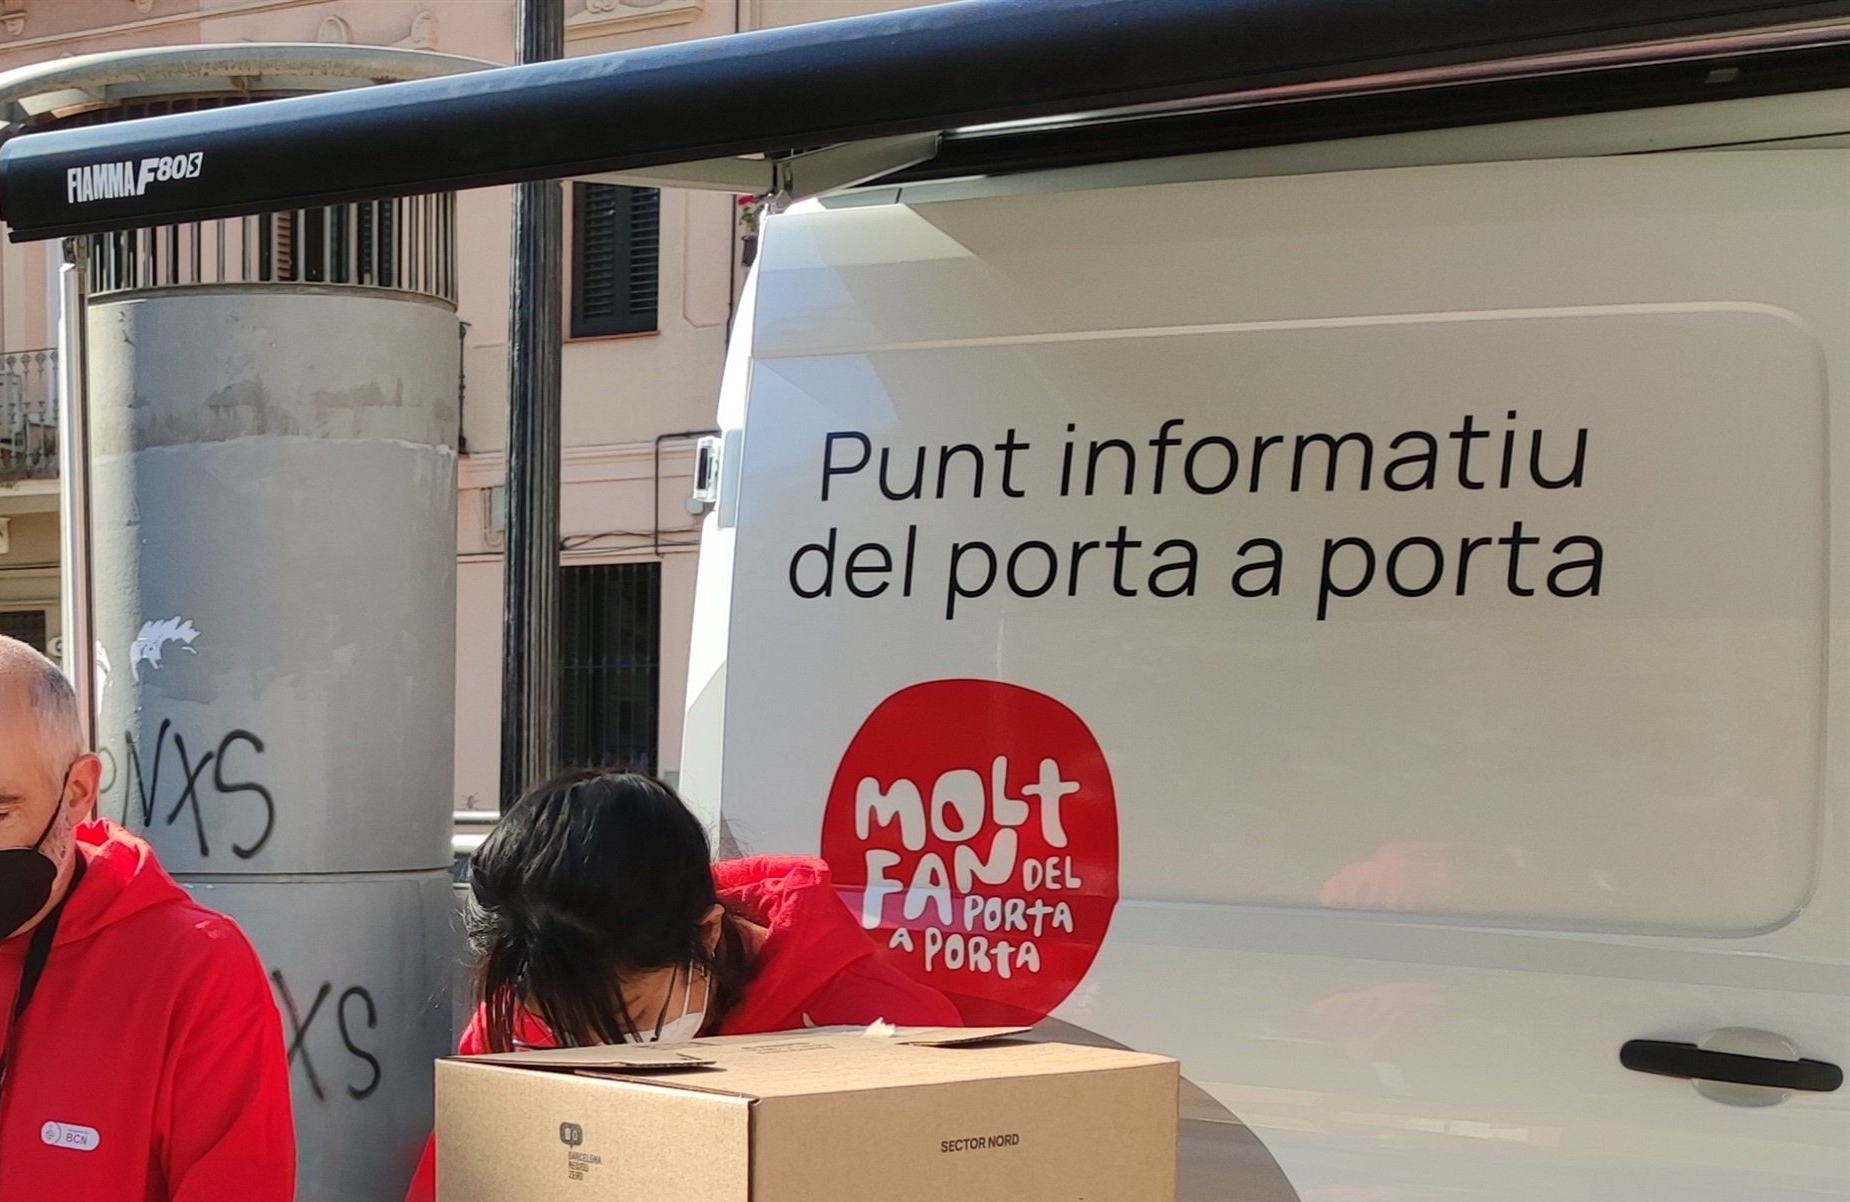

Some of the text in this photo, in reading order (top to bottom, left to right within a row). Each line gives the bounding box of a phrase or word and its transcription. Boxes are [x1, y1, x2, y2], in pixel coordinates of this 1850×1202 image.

[67, 161, 135, 203] FIAMMA
[821, 410, 1589, 501] Punt informatiu
[787, 521, 1606, 622] del porta a porta
[855, 755, 1081, 851] MOLT
[862, 827, 1082, 930] FAN DEL
[964, 895, 1074, 937] PORTA
[889, 927, 1041, 980] A PORTA
[65, 1132, 88, 1145] BCN
[940, 1133, 1020, 1153] SECTOR NORD
